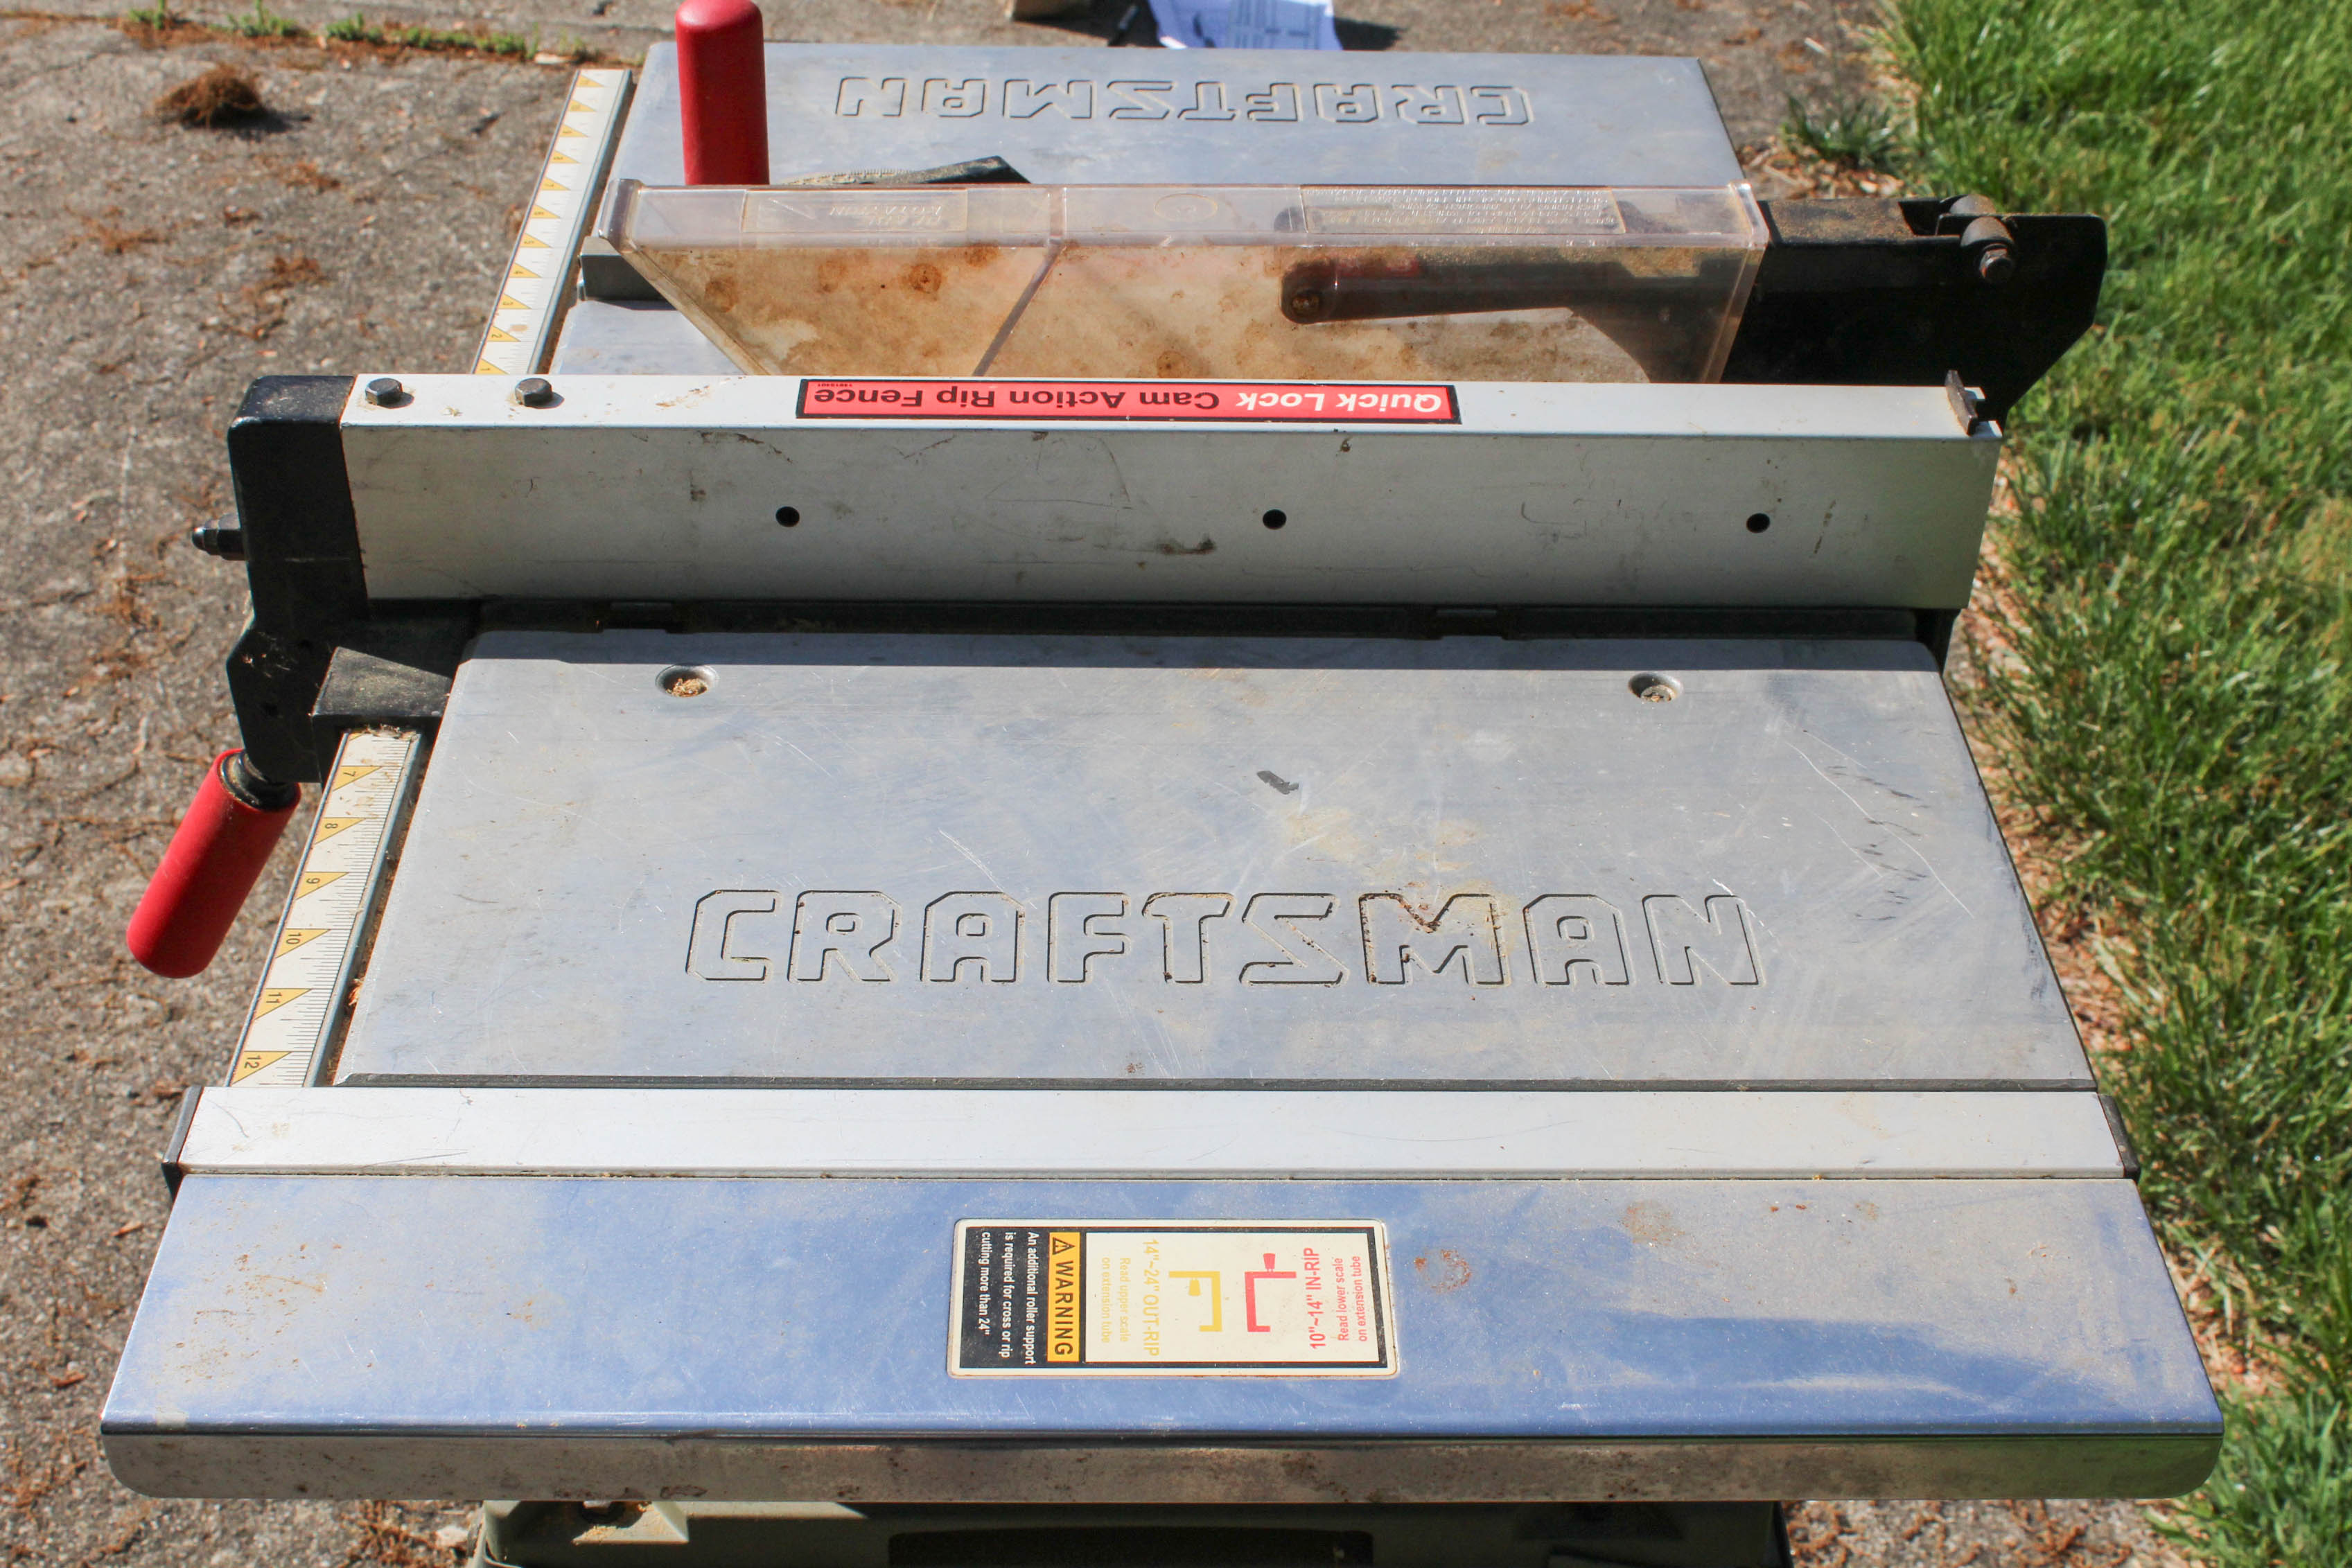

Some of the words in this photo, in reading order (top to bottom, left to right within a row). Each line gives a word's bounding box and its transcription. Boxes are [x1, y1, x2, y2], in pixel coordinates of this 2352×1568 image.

[834, 76, 1532, 127] CRAFTSMAN
[814, 389, 923, 407] Fence
[937, 385, 995, 407] Rip
[1009, 390, 1126, 409] Action
[1139, 391, 1220, 410] Cam
[1236, 391, 1326, 412] Lock
[1336, 392, 1442, 412] Quick
[286, 932, 302, 945] 10
[686, 888, 1764, 987] CRAFTSMAN
[265, 992, 282, 1005] 11
[243, 1055, 261, 1069] 12
[1005, 1231, 1017, 1241] is
[1028, 1231, 1039, 1246] An
[978, 1231, 992, 1265] cutting
[1001, 1242, 1016, 1283] required
[1026, 1248, 1039, 1295] additional
[1101, 1257, 1111, 1269] on
[1119, 1258, 1131, 1283] Read
[1304, 1248, 1321, 1289] IN-RIP
[1332, 1258, 1344, 1283] scale
[1349, 1256, 1362, 1277] tube
[979, 1267, 990, 1291] more
[1003, 1285, 1015, 1299] for
[1101, 1271, 1112, 1319] extension
[1116, 1285, 1129, 1313] upper
[1336, 1286, 1347, 1313] lower
[1353, 1279, 1366, 1326] extension
[978, 1294, 991, 1316] than
[1002, 1301, 1012, 1328] cross
[1026, 1296, 1038, 1323] roller
[1054, 1260, 1074, 1355] WARNING
[978, 1318, 990, 1335] 24"
[1001, 1330, 1011, 1342] or
[1100, 1321, 1114, 1343] tube
[1119, 1316, 1131, 1342] scale
[1142, 1294, 1160, 1357] OUT-RIP
[1336, 1315, 1349, 1341] Read
[1358, 1330, 1368, 1342] on
[999, 1344, 1013, 1358] rip
[1022, 1325, 1036, 1364] support
